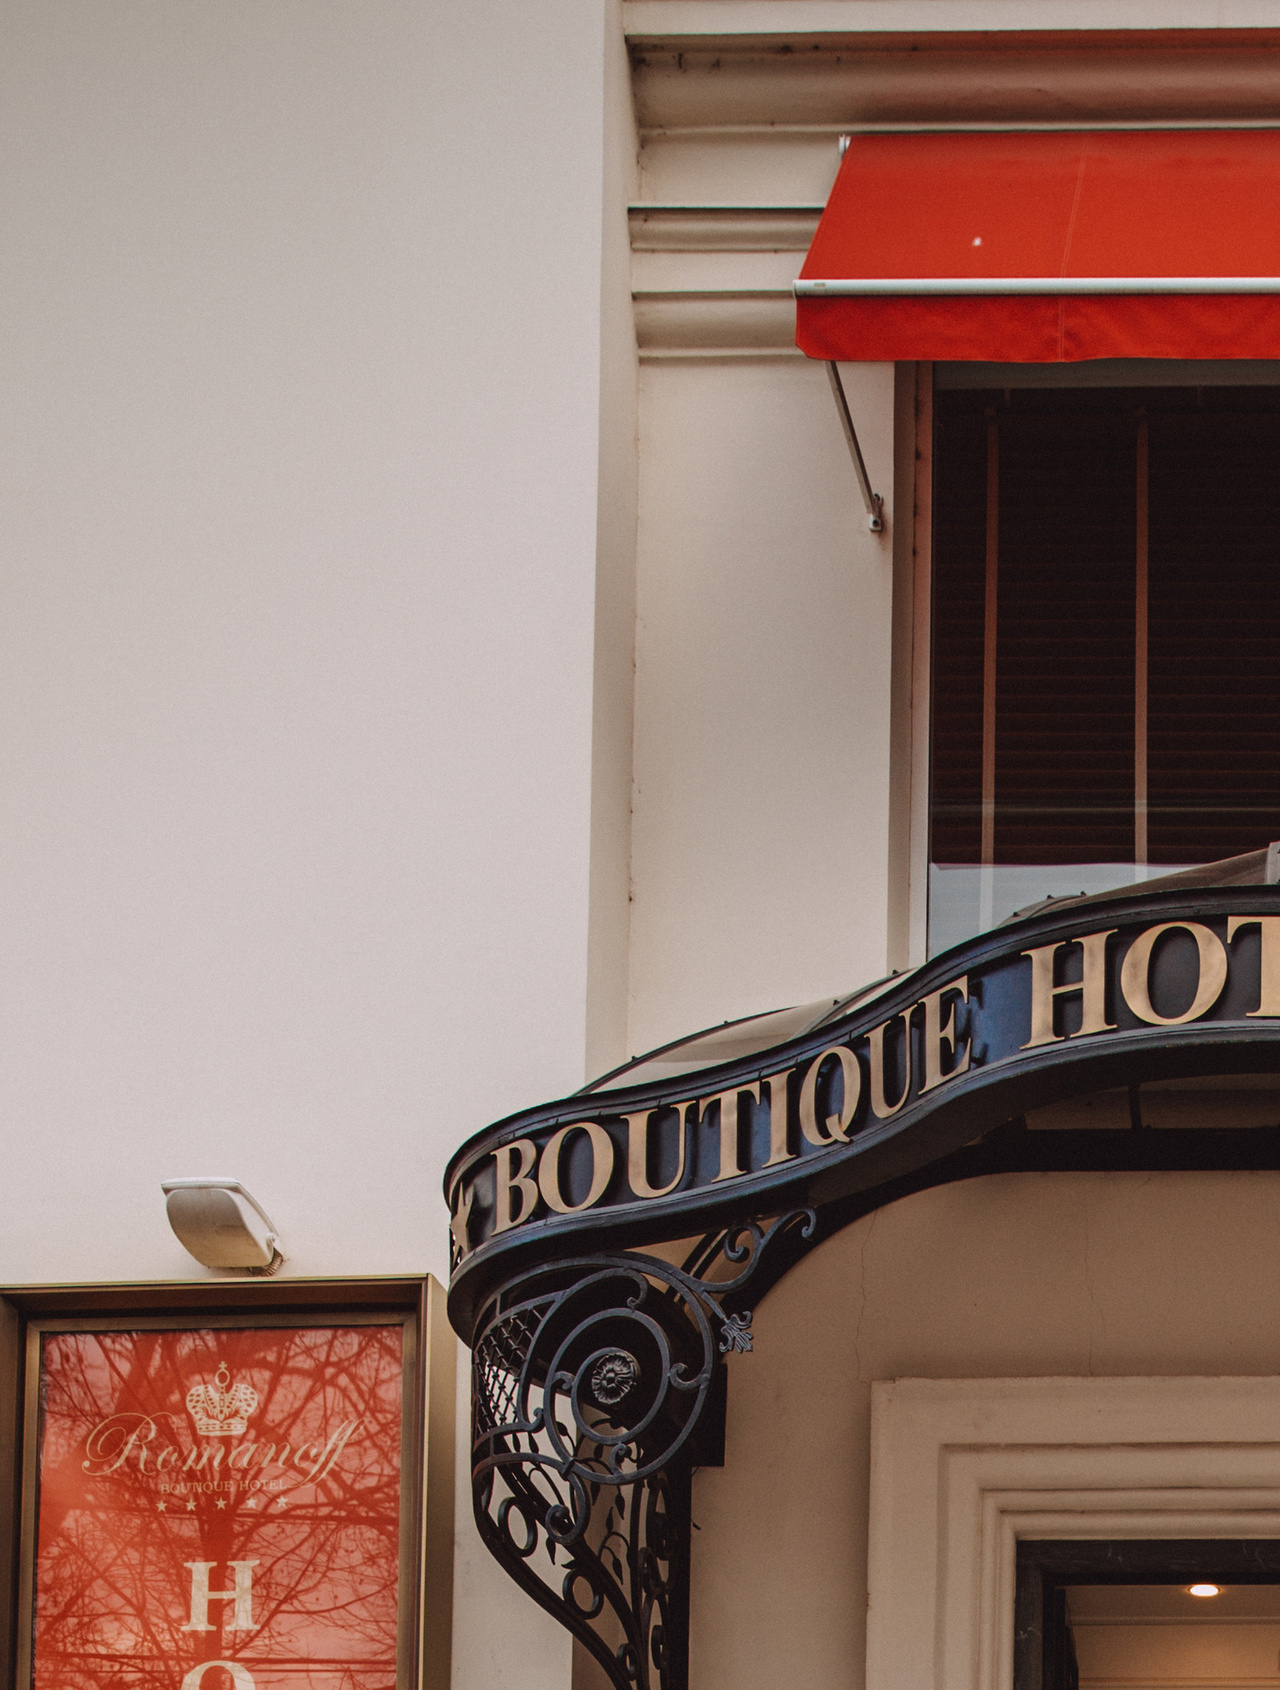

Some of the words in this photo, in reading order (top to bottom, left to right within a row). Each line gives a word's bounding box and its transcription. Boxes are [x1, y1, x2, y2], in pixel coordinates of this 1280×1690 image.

[490, 974, 973, 1237] BOUTIQUE
[81, 1411, 367, 1488] Romanoff
[160, 1481, 233, 1494] BOUTIQUE
[239, 1479, 287, 1492] HOTEL
